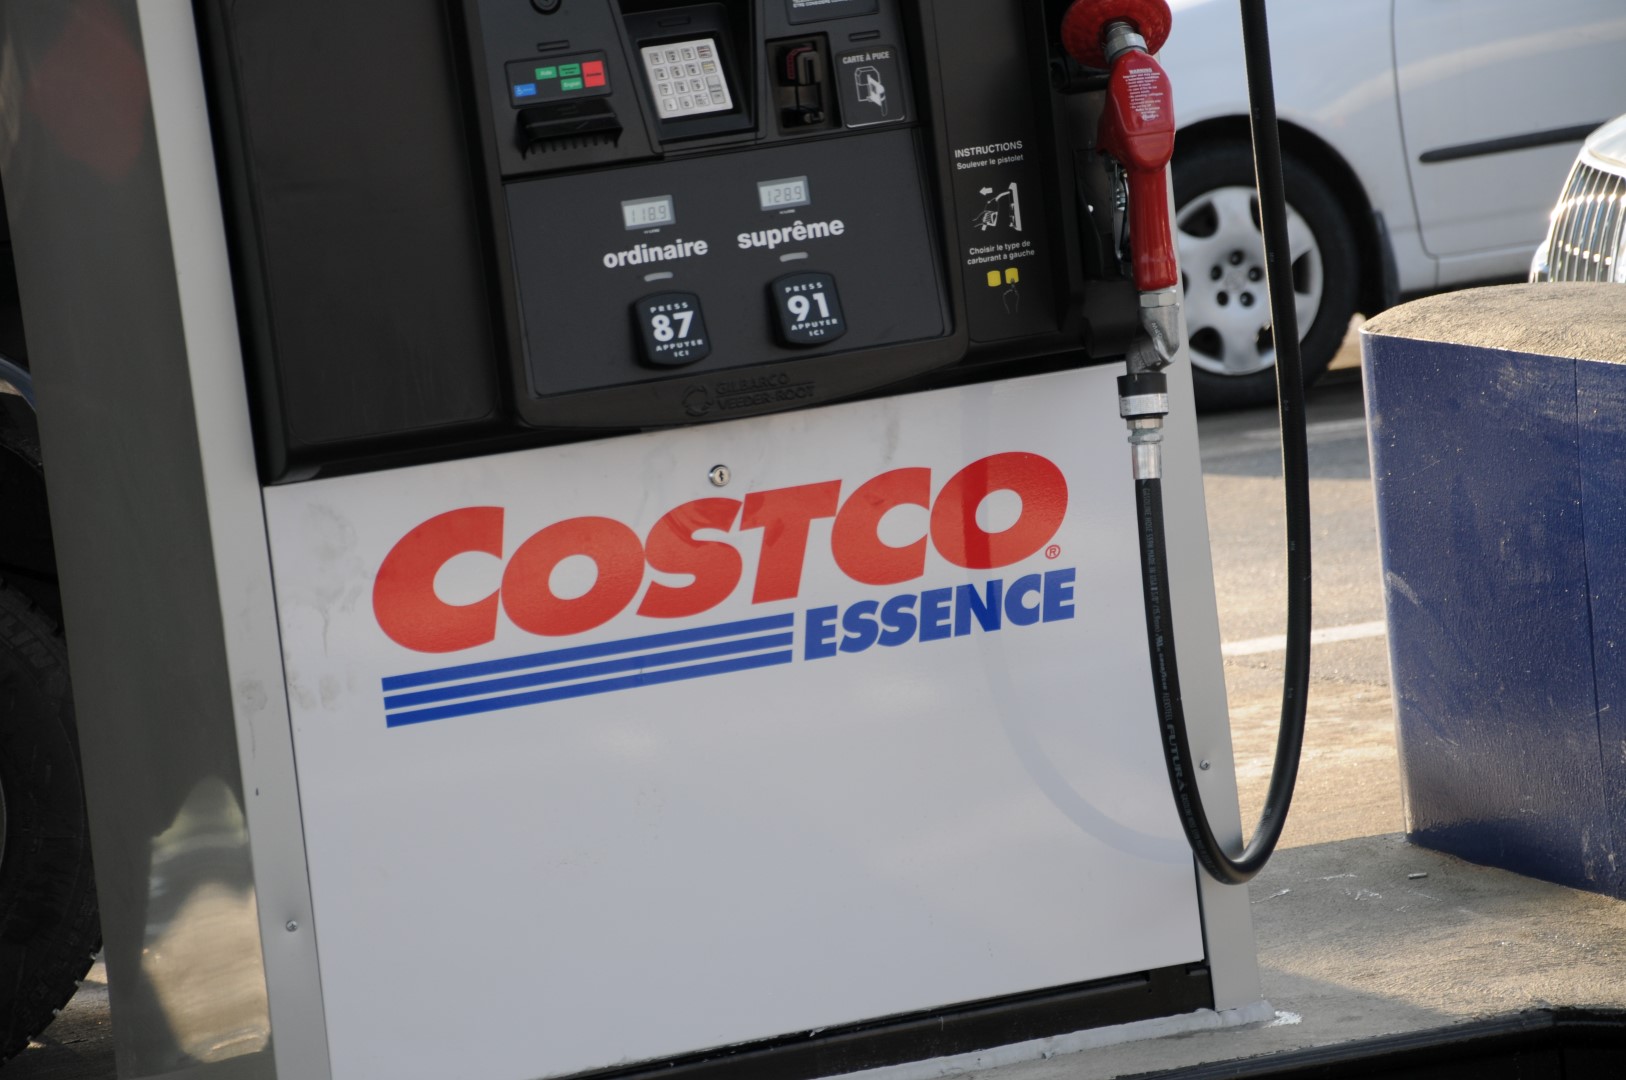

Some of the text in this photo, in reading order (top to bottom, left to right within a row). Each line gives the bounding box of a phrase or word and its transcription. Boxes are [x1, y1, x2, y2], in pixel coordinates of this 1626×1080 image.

[842, 51, 890, 64] CARTE À PUCE
[954, 141, 1023, 158] INSTRUCTIONS
[957, 154, 1024, 170] Soulever le pistolet
[737, 219, 845, 249] suprême
[603, 239, 708, 268] ordinaire
[969, 240, 1031, 256] Choisir le type de
[967, 254, 1001, 265] carburant
[1009, 249, 1035, 261] gauche
[785, 281, 823, 293] PRESS
[650, 302, 689, 313] PRESS
[787, 292, 830, 322] 91
[651, 310, 694, 342] 87
[790, 318, 838, 331] APPUYER
[809, 329, 825, 337] ICI
[655, 339, 703, 352] APPUYER
[674, 350, 690, 358] ICI
[715, 373, 791, 395] GILBARCO
[372, 451, 1069, 654] COSTCO
[804, 567, 1076, 661] ESSENCE
[1166, 723, 1186, 793] FUTURA
